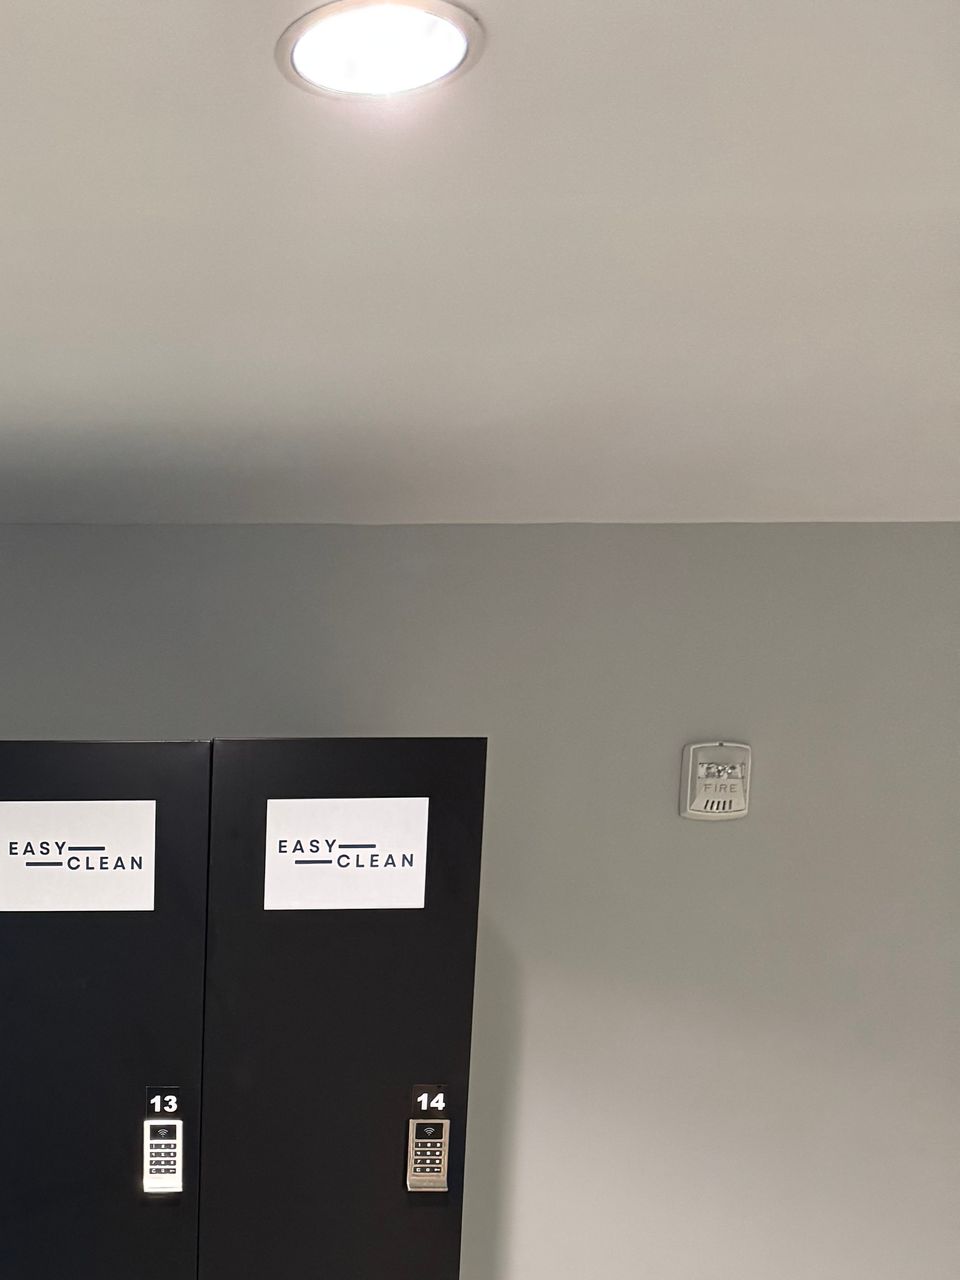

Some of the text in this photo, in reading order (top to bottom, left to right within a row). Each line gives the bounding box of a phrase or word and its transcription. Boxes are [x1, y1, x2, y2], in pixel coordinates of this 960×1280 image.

[704, 783, 737, 793] FIRE
[9, 841, 67, 855] EASY
[278, 839, 337, 853] EASY
[67, 856, 143, 870] CLEAN
[336, 853, 414, 868] CLEAN
[150, 1095, 177, 1112] 13
[417, 1093, 446, 1110] 14
